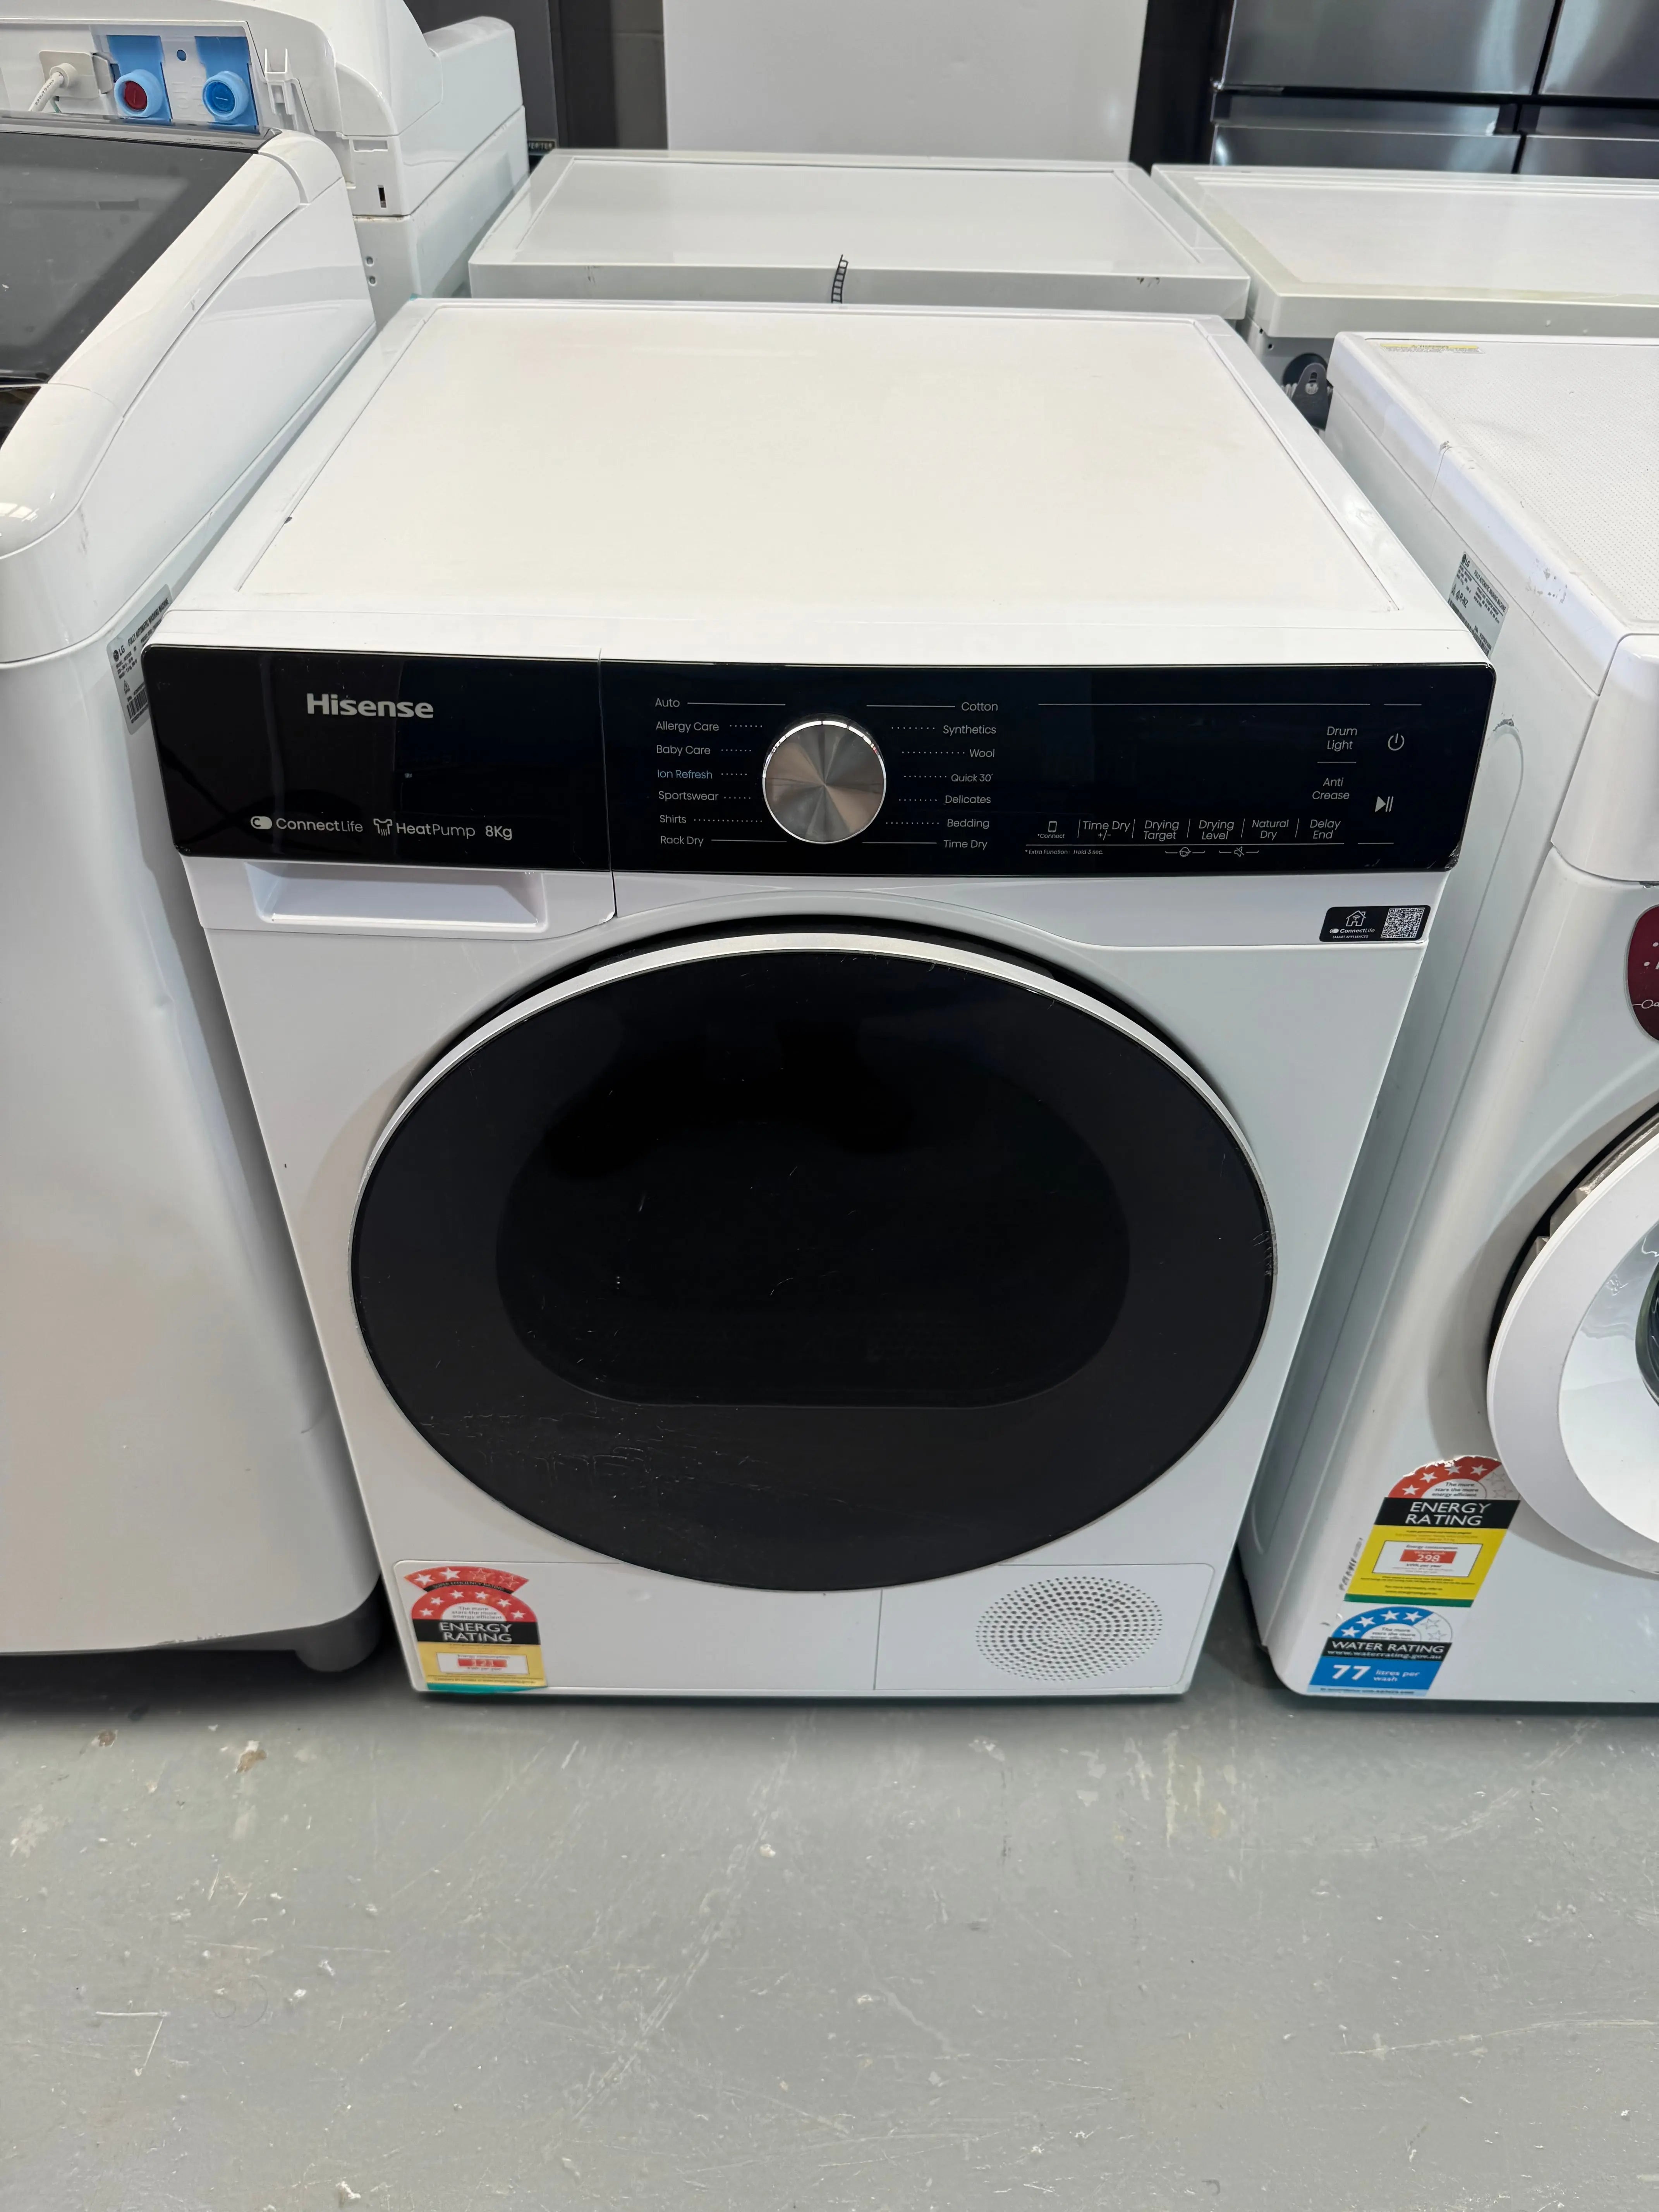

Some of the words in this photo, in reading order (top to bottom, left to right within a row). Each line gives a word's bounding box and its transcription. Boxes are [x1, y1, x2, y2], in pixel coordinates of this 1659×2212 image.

[118, 645, 125, 656] LG
[307, 693, 434, 718] Hisense
[655, 698, 680, 708] Auto
[961, 702, 998, 711] Cotton
[656, 721, 691, 733] Allergy
[694, 722, 719, 731] Care
[943, 725, 996, 737] Synthetics
[1327, 726, 1357, 736] Drum
[656, 745, 683, 756] Baby
[685, 745, 711, 755] Care
[1327, 740, 1353, 752] Light
[969, 749, 995, 757] Wool
[657, 769, 673, 778] Ion
[676, 769, 713, 779] Refresh
[951, 773, 977, 782] Quick
[1322, 777, 1344, 787] Anti
[658, 790, 719, 802] Sportswear
[945, 795, 991, 804] Delicates
[1312, 791, 1350, 800] Crease
[659, 814, 687, 823] Shirts
[947, 818, 989, 830] Bedding
[1252, 819, 1289, 828] Natural
[276, 817, 363, 832] ConnectLife
[1083, 821, 1109, 831] Time
[1111, 819, 1132, 833] Dry
[1144, 820, 1179, 832] Drying
[1199, 819, 1235, 831] Drying
[1310, 819, 1341, 831] Delay
[396, 823, 475, 840] HeatPump
[485, 825, 512, 841] 8Kg
[1143, 830, 1177, 842] Target
[1202, 829, 1230, 840] Level
[1260, 830, 1278, 841] Dry
[1313, 830, 1333, 839] End
[660, 835, 685, 844] Rack
[687, 836, 704, 847] Dry
[943, 840, 968, 848] Time
[970, 840, 988, 850] Dry
[1410, 1501, 1491, 1513] ENERGY
[1405, 1514, 1483, 1526] RATING
[1416, 1554, 1441, 1562] 298
[440, 1622, 512, 1632] ENERGY
[443, 1632, 512, 1642] RATING
[1331, 1640, 1383, 1651] WATER
[1387, 1642, 1445, 1653] RATING
[1327, 1650, 1442, 1660] www.waterrating.gov.au
[1332, 1665, 1371, 1680] 77
